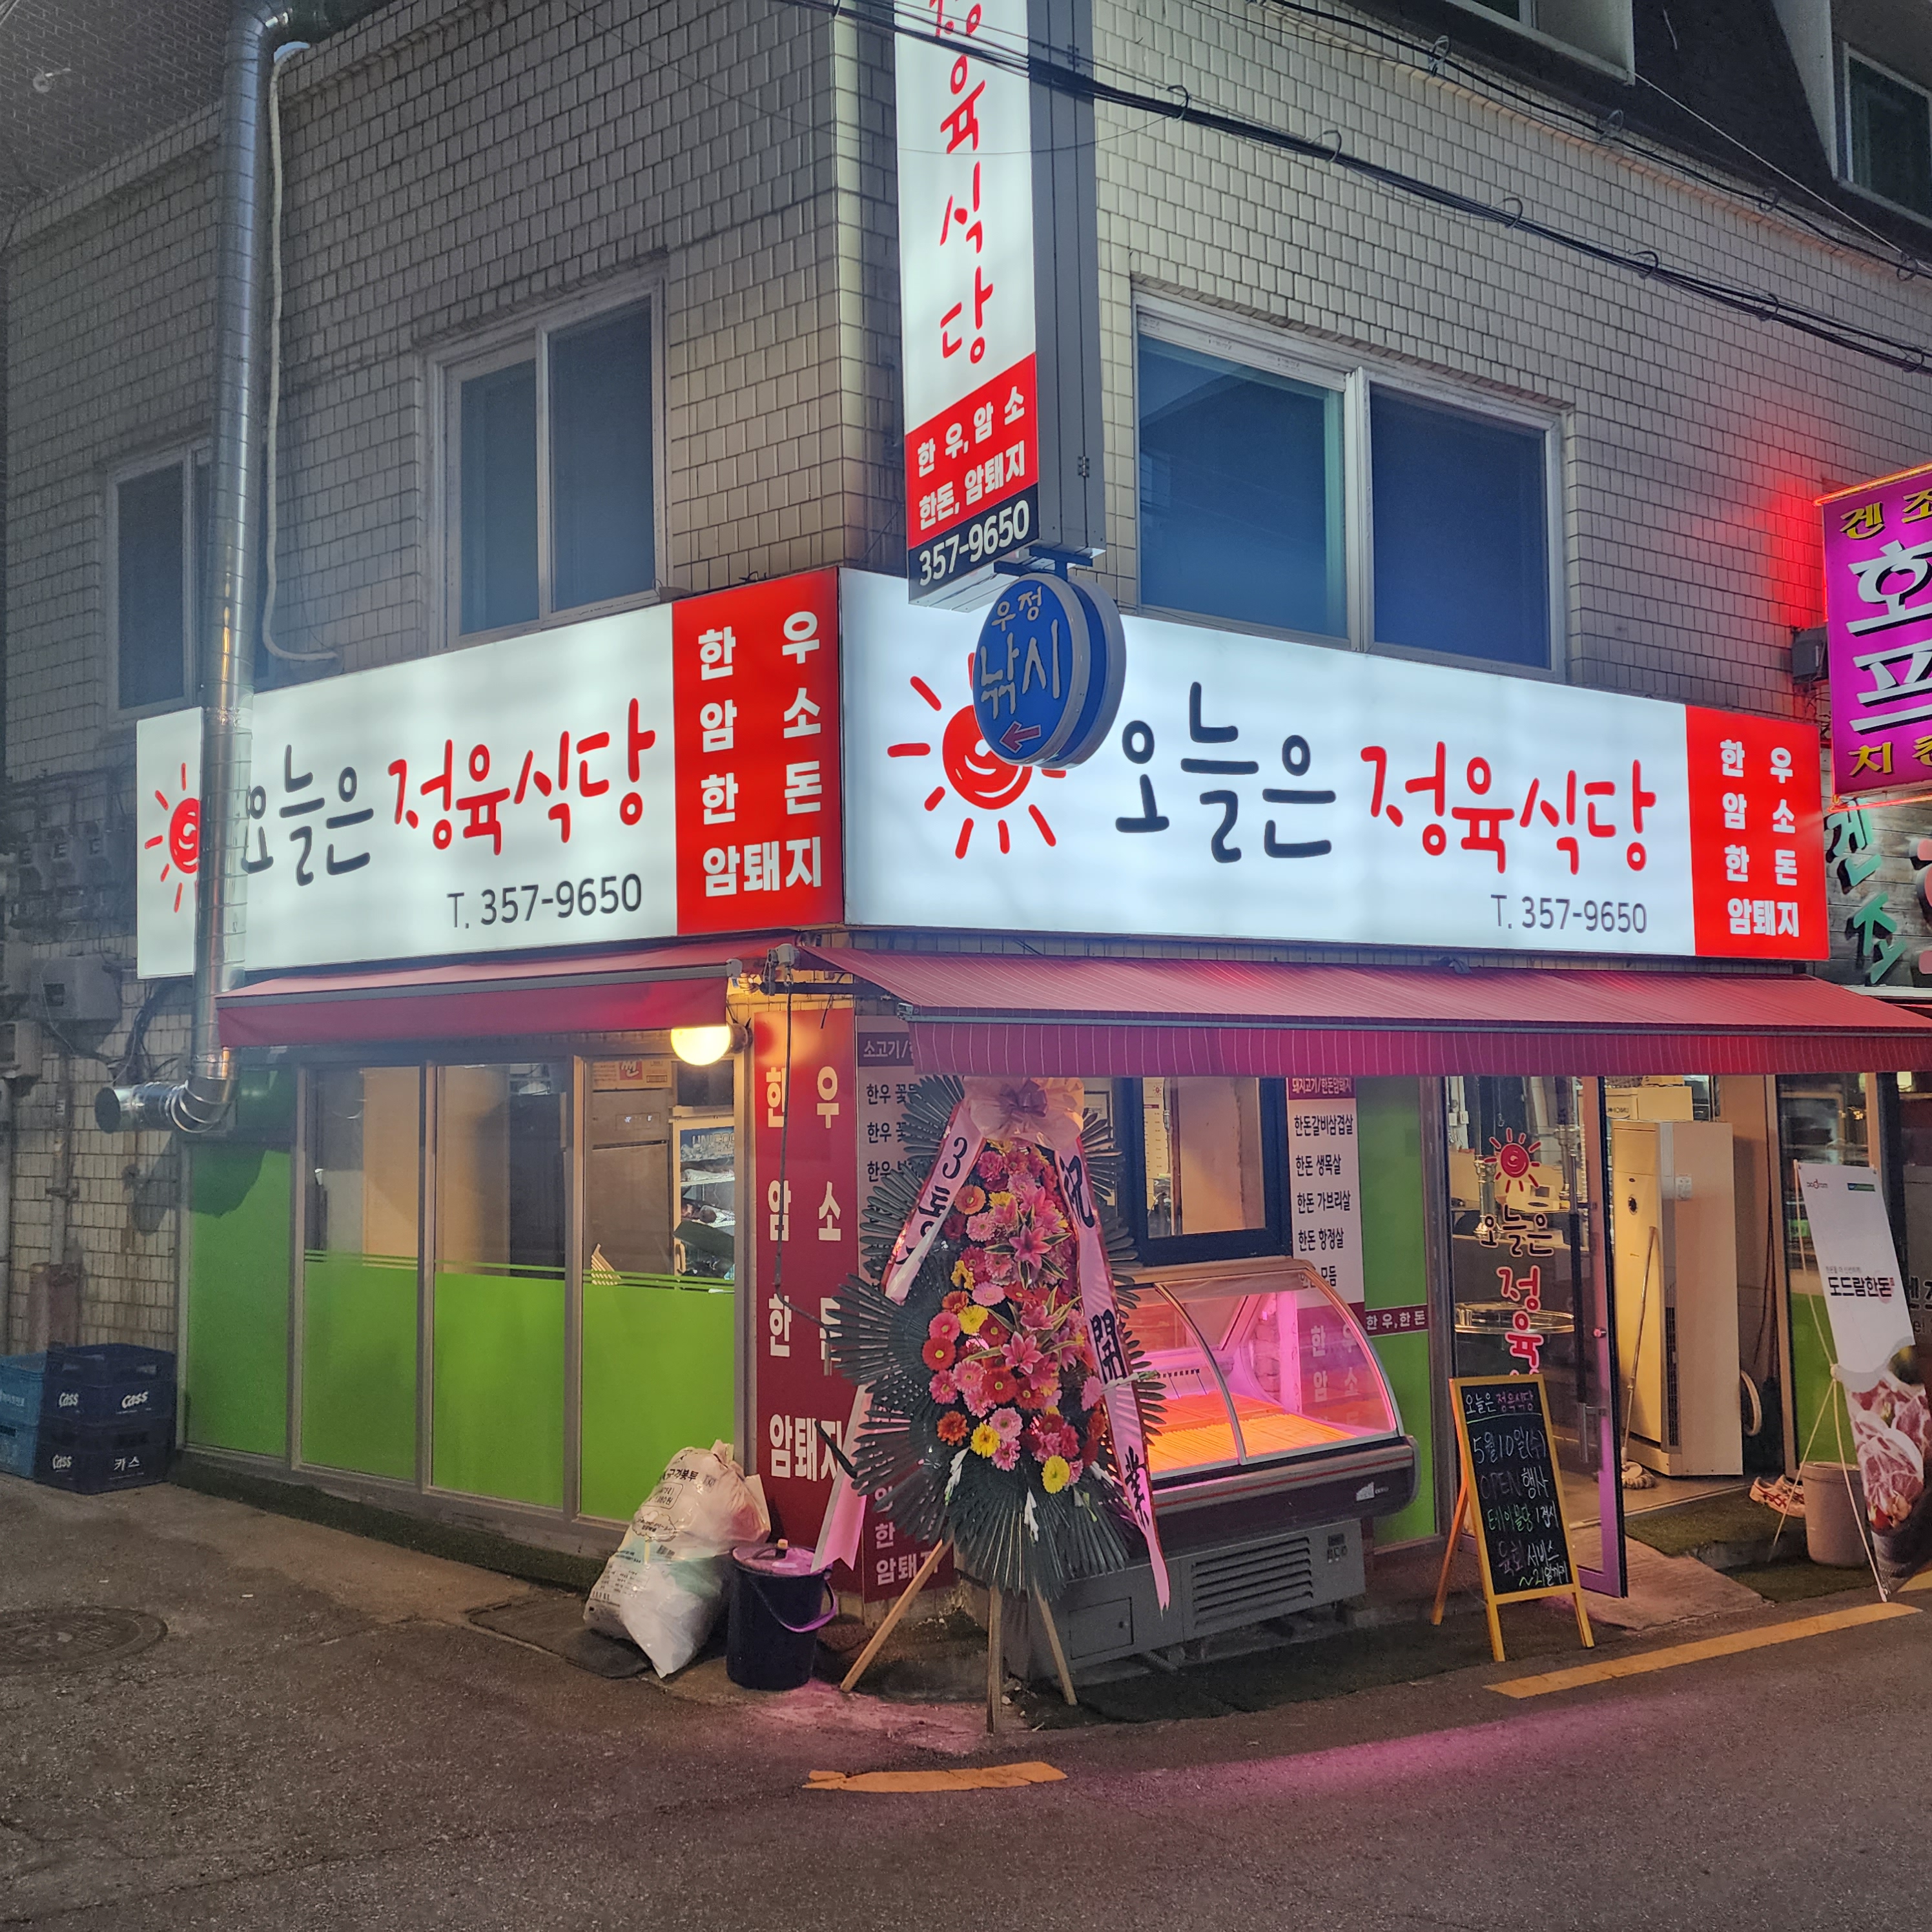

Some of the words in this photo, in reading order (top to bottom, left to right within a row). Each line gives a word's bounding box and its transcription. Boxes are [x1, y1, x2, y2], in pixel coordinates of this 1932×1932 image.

[919, 500, 1029, 586] 357-9650
[991, 586, 1042, 632] 우정
[980, 619, 1060, 720] 낚시
[1115, 681, 1336, 863] 오늘은
[1361, 741, 1656, 875] 정육식당
[248, 745, 374, 887] 오늘은
[389, 699, 655, 854] 정육식당
[703, 836, 822, 897] 암퇘지
[480, 873, 642, 926] 357-9650
[1521, 896, 1647, 934] 357-9650
[1727, 898, 1800, 938] 암퇘지
[863, 1039, 914, 1060] 소고기/
[866, 1084, 891, 1105] 한우
[867, 1122, 892, 1144] 한우
[1294, 1114, 1353, 1136] 한돈갈비삼겹살
[867, 1160, 892, 1183] 한우
[1295, 1155, 1313, 1177] 한돈
[1316, 1153, 1342, 1177] 생목살
[1297, 1192, 1315, 1214] 한돈
[1317, 1190, 1351, 1211] 가브리살
[1298, 1229, 1316, 1252] 한돈
[1319, 1228, 1345, 1251] 항정살
[1480, 1203, 1554, 1257] 오늘은
[1828, 1276, 1892, 1298] 도드람한돈
[1497, 1264, 1544, 1376] 정육
[59, 1392, 79, 1408] Cass
[121, 1390, 149, 1409] Cass
[1466, 1392, 1497, 1414] 오늘은
[113, 1455, 140, 1472] 카스
[1521, 1466, 1549, 1499] 행사
[1528, 1539, 1560, 1567] 서비스
